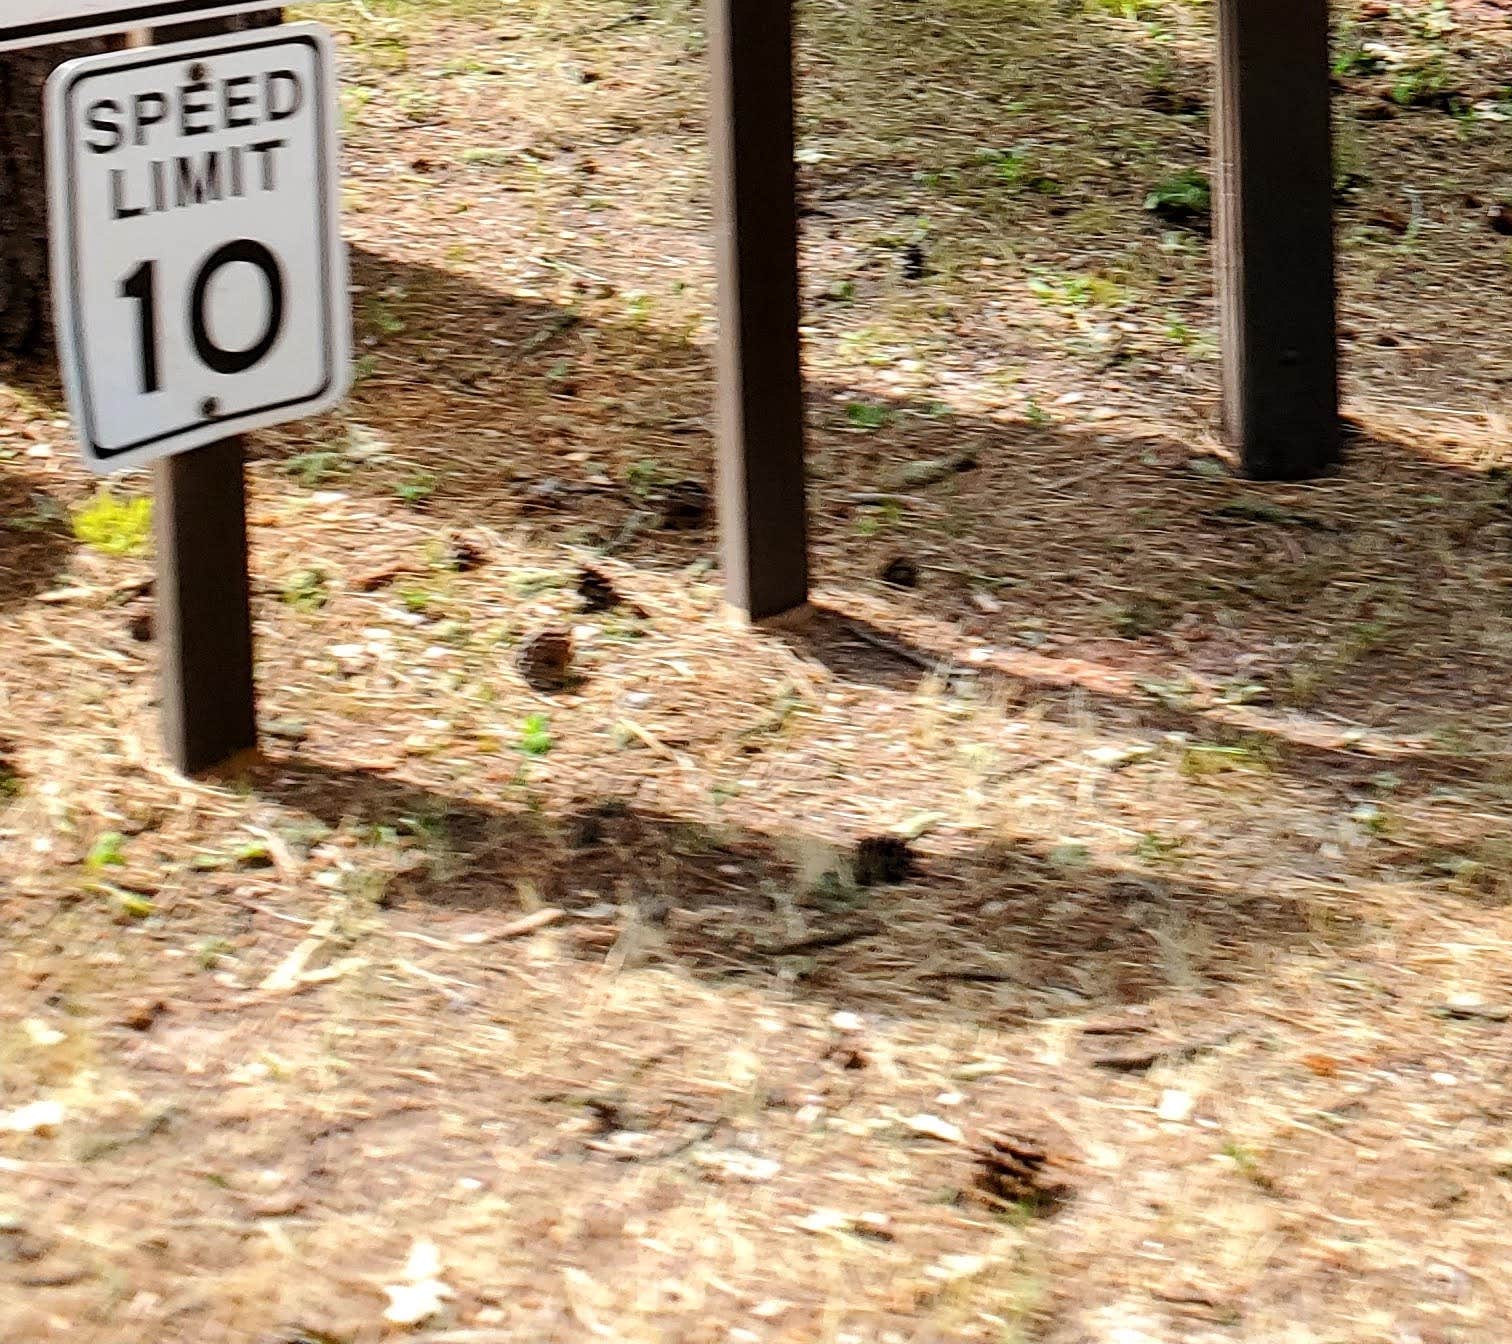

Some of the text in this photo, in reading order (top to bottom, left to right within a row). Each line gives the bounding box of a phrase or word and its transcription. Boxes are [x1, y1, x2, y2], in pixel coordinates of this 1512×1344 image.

[85, 69, 303, 154] SPEED
[107, 138, 289, 220] LIMIT
[116, 238, 284, 395] 10
